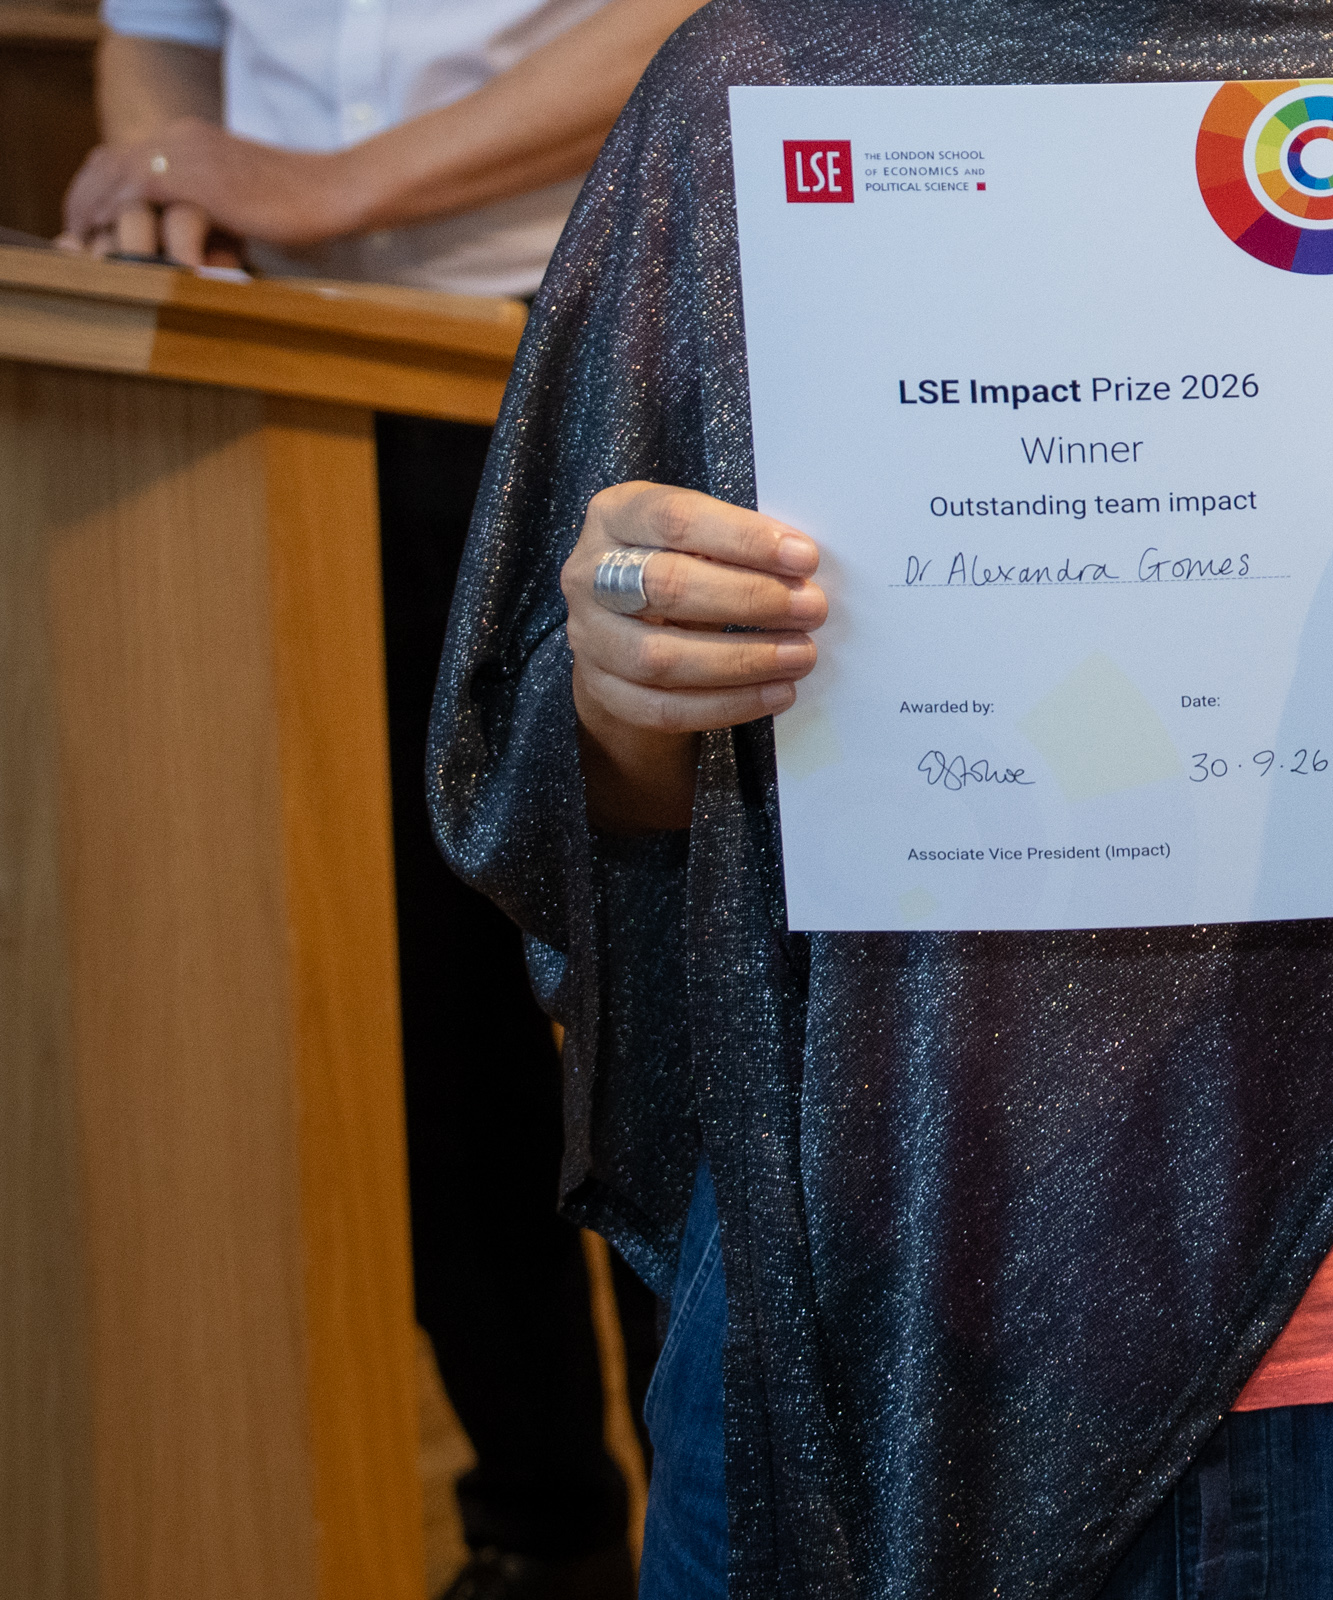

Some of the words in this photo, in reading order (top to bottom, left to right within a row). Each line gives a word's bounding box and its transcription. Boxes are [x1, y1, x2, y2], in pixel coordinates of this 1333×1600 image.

[864, 152, 881, 161] THE
[884, 150, 935, 161] LONDON
[938, 150, 985, 161] SCHOOL
[795, 150, 842, 192] LSE
[864, 168, 878, 177] OF
[882, 166, 959, 177] ECONOMICS
[963, 167, 986, 176] AND
[864, 181, 922, 192] POLITICAL
[924, 181, 970, 192] SCIENCE
[898, 378, 961, 406] LSE
[969, 376, 1082, 411] Impact
[1091, 374, 1172, 403] Prize
[1180, 371, 1261, 401] 2026
[1020, 435, 1144, 465] Winner
[929, 493, 1087, 521] Outstanding
[1093, 494, 1161, 515] team
[1168, 490, 1258, 518] impact
[904, 554, 932, 586] Dr
[947, 551, 1120, 584] Alexandra
[1138, 546, 1250, 581] Gomes
[899, 699, 969, 714] Awarded
[971, 699, 995, 718] by:
[1180, 694, 1221, 709] Date:
[907, 847, 985, 862] Associate
[988, 846, 1023, 861] Vice
[1026, 845, 1101, 861] President
[1104, 842, 1171, 862] (Impact)
